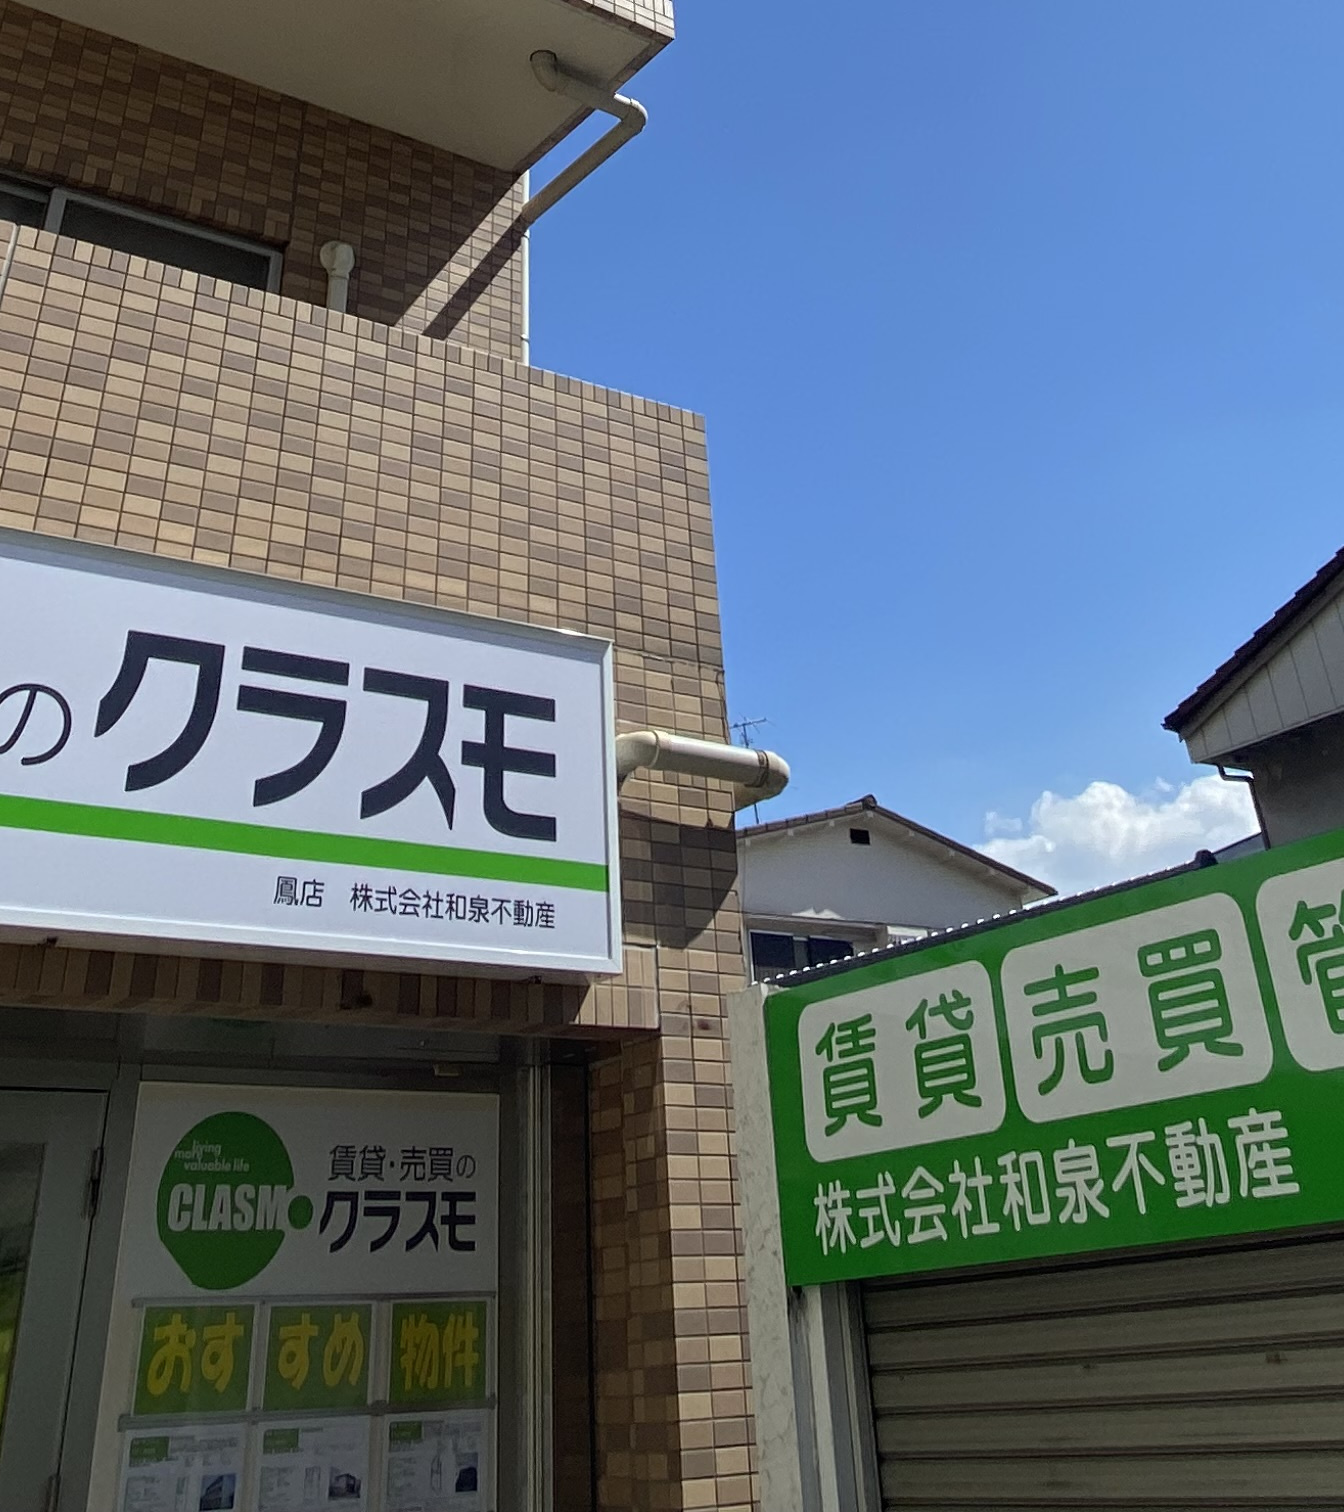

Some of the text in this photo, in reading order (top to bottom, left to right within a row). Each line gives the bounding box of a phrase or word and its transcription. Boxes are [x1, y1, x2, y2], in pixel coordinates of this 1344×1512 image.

[349, 883, 556, 929] 株式会社和泉不動産
[814, 989, 983, 1137] 賃貸
[1023, 928, 1245, 1096] 売買
[319, 1190, 477, 1253] クラスモ
[813, 1108, 1301, 1257] 株式会社和泉不動産
